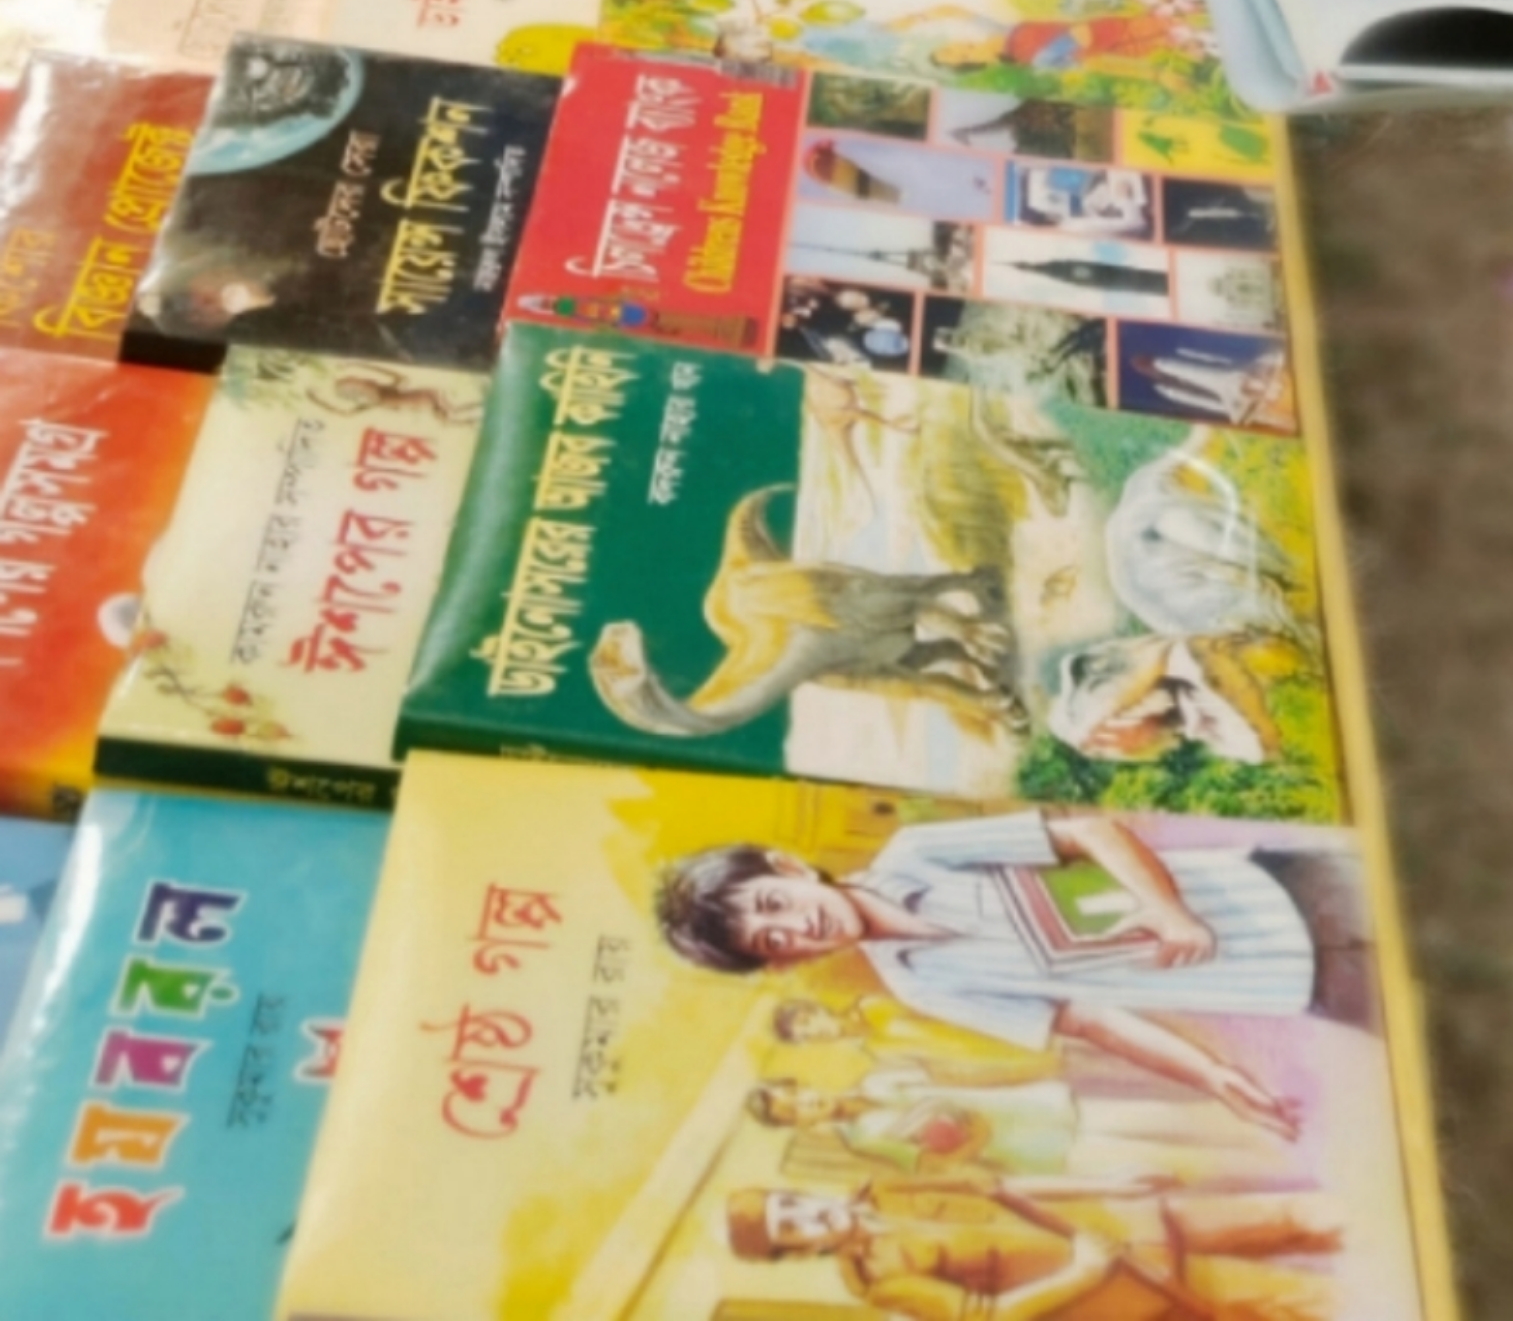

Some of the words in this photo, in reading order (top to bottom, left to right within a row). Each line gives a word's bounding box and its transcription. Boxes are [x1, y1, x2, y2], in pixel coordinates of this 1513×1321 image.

[380, 95, 492, 212] ফিকশন
[33, 236, 150, 341] বিজ্ঞান
[343, 426, 439, 493] গল্প
[530, 431, 617, 511] আজব
[280, 508, 415, 674] ঈশপের
[470, 517, 596, 697] ডাইনোসরের
[467, 882, 564, 976] গল্প
[591, 934, 632, 985] রায়
[417, 1001, 543, 1140] শ্রেষ্ঠ
[571, 994, 622, 1102] সুকুমার
